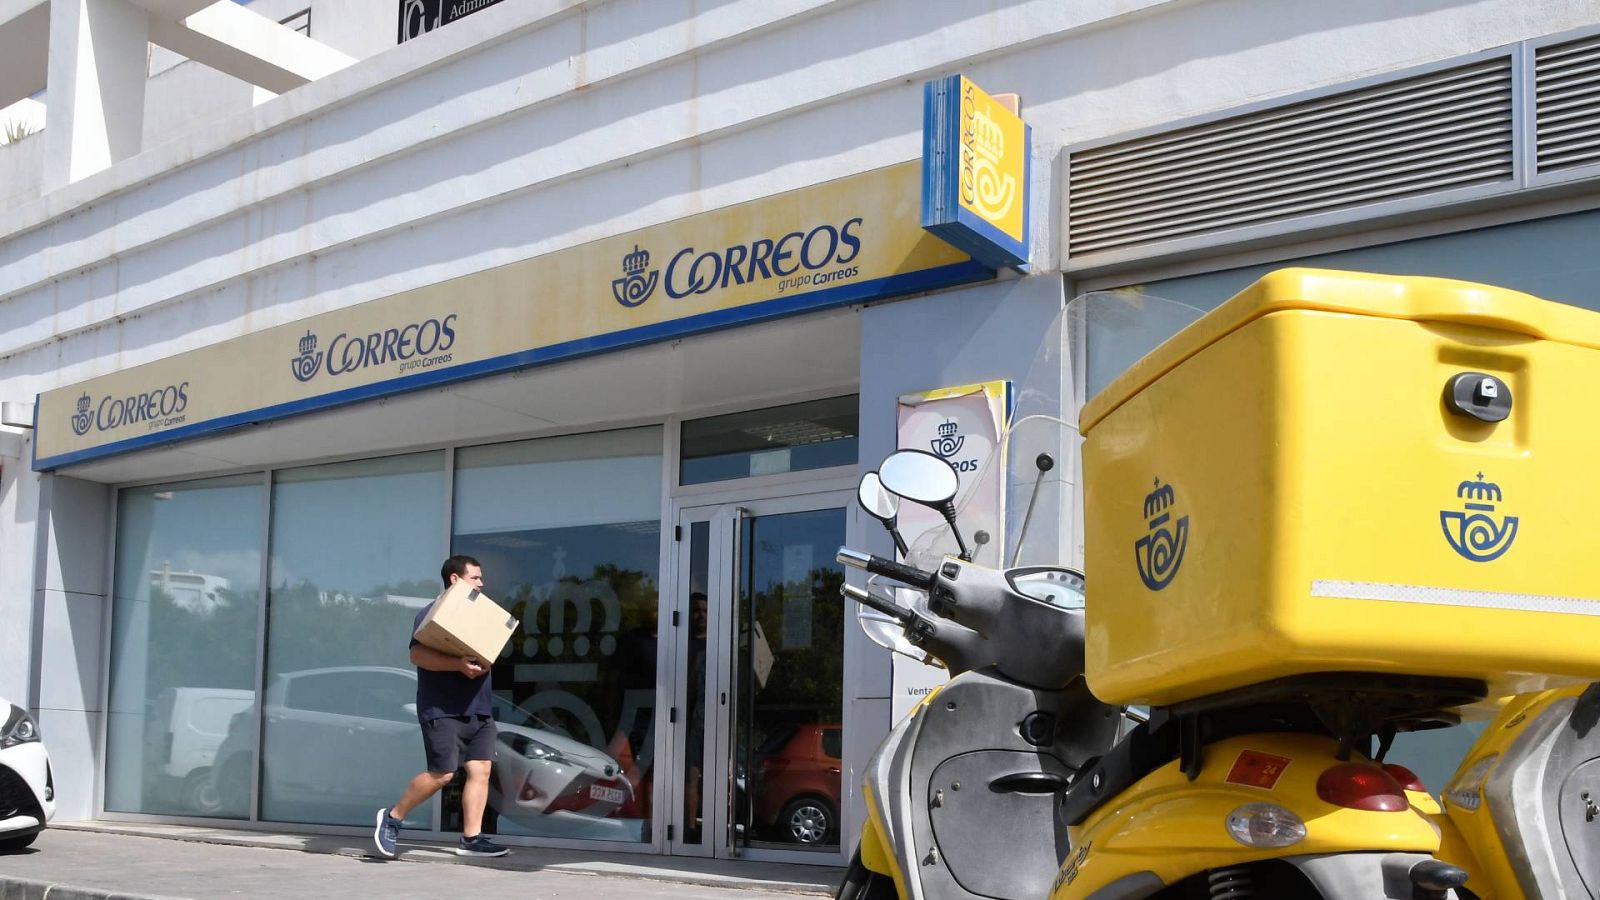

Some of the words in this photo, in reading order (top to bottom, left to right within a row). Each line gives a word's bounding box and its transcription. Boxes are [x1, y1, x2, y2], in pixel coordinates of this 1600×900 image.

[962, 82, 975, 205] CORREOS
[664, 218, 863, 299] CORREOS
[778, 273, 811, 293] grupo
[813, 266, 859, 286] Correos
[326, 314, 458, 376] CORREOS
[400, 359, 422, 374] grupo
[422, 353, 453, 368] Correos
[97, 382, 189, 431] CORREOS
[951, 459, 978, 472] eos
